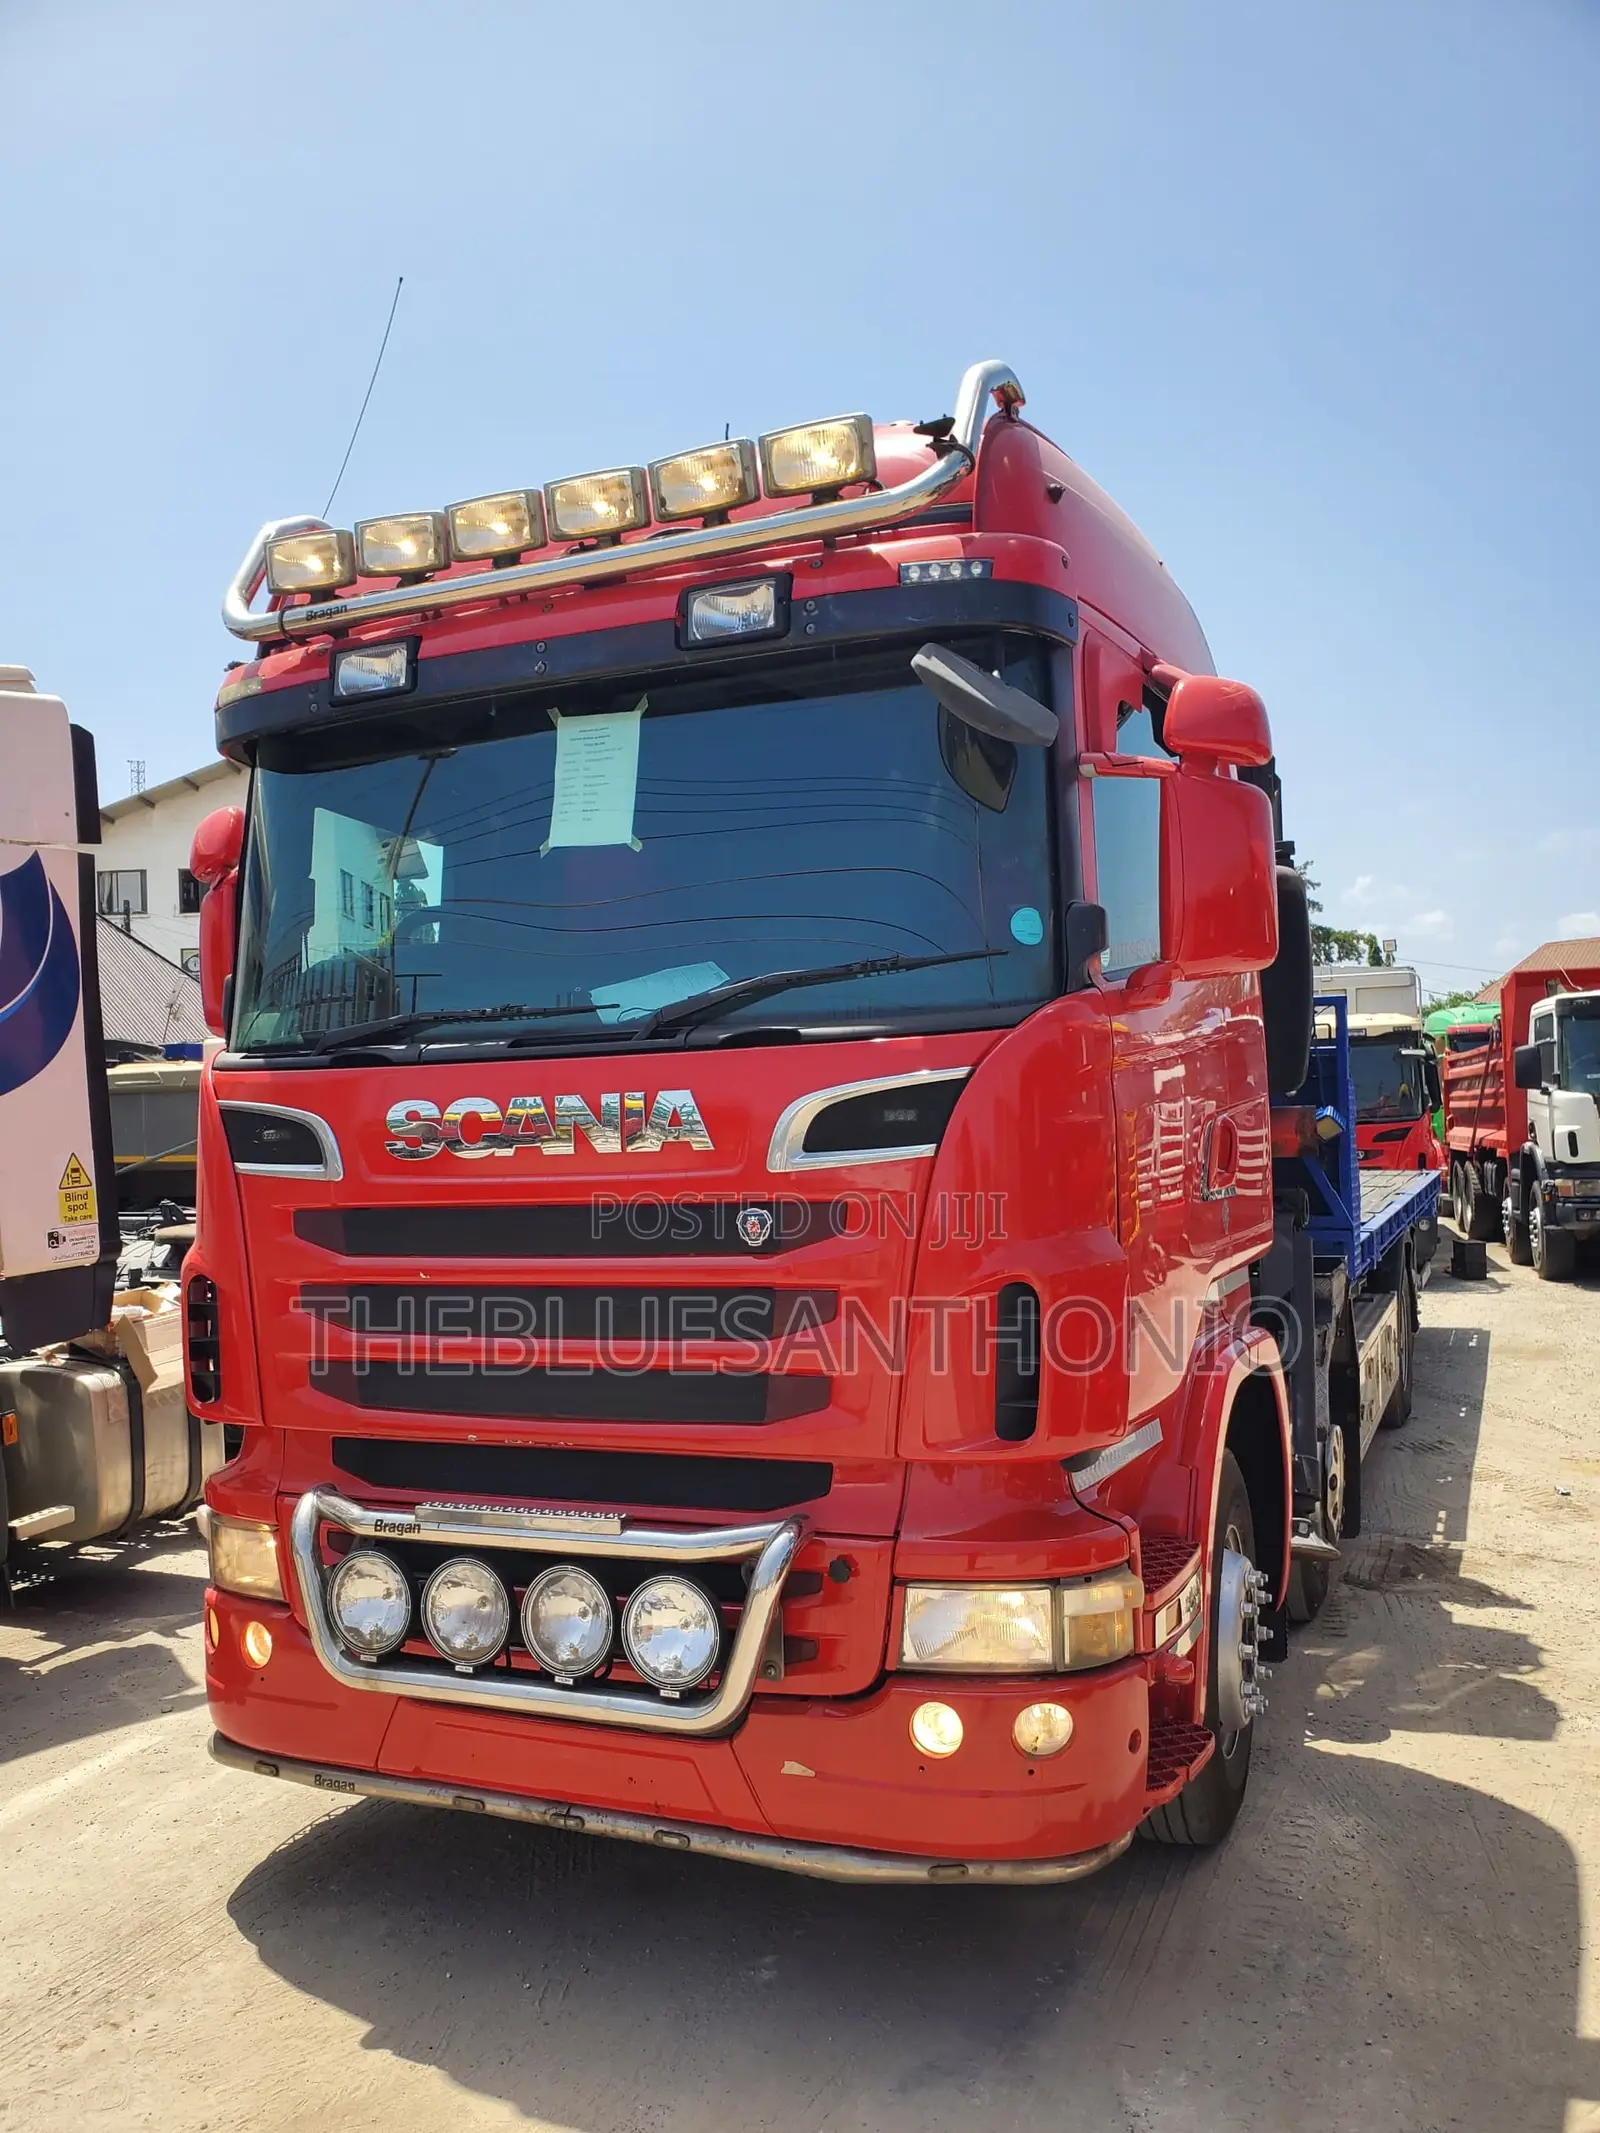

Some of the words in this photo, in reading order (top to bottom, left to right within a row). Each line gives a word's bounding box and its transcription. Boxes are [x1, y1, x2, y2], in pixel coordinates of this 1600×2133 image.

[305, 604, 348, 621] Bragan
[384, 1088, 715, 1161] SCANIA
[64, 1190, 89, 1203] Blind
[67, 1201, 88, 1213] spot
[374, 1519, 421, 1536] Bragan
[314, 1773, 356, 1792] Bragan
